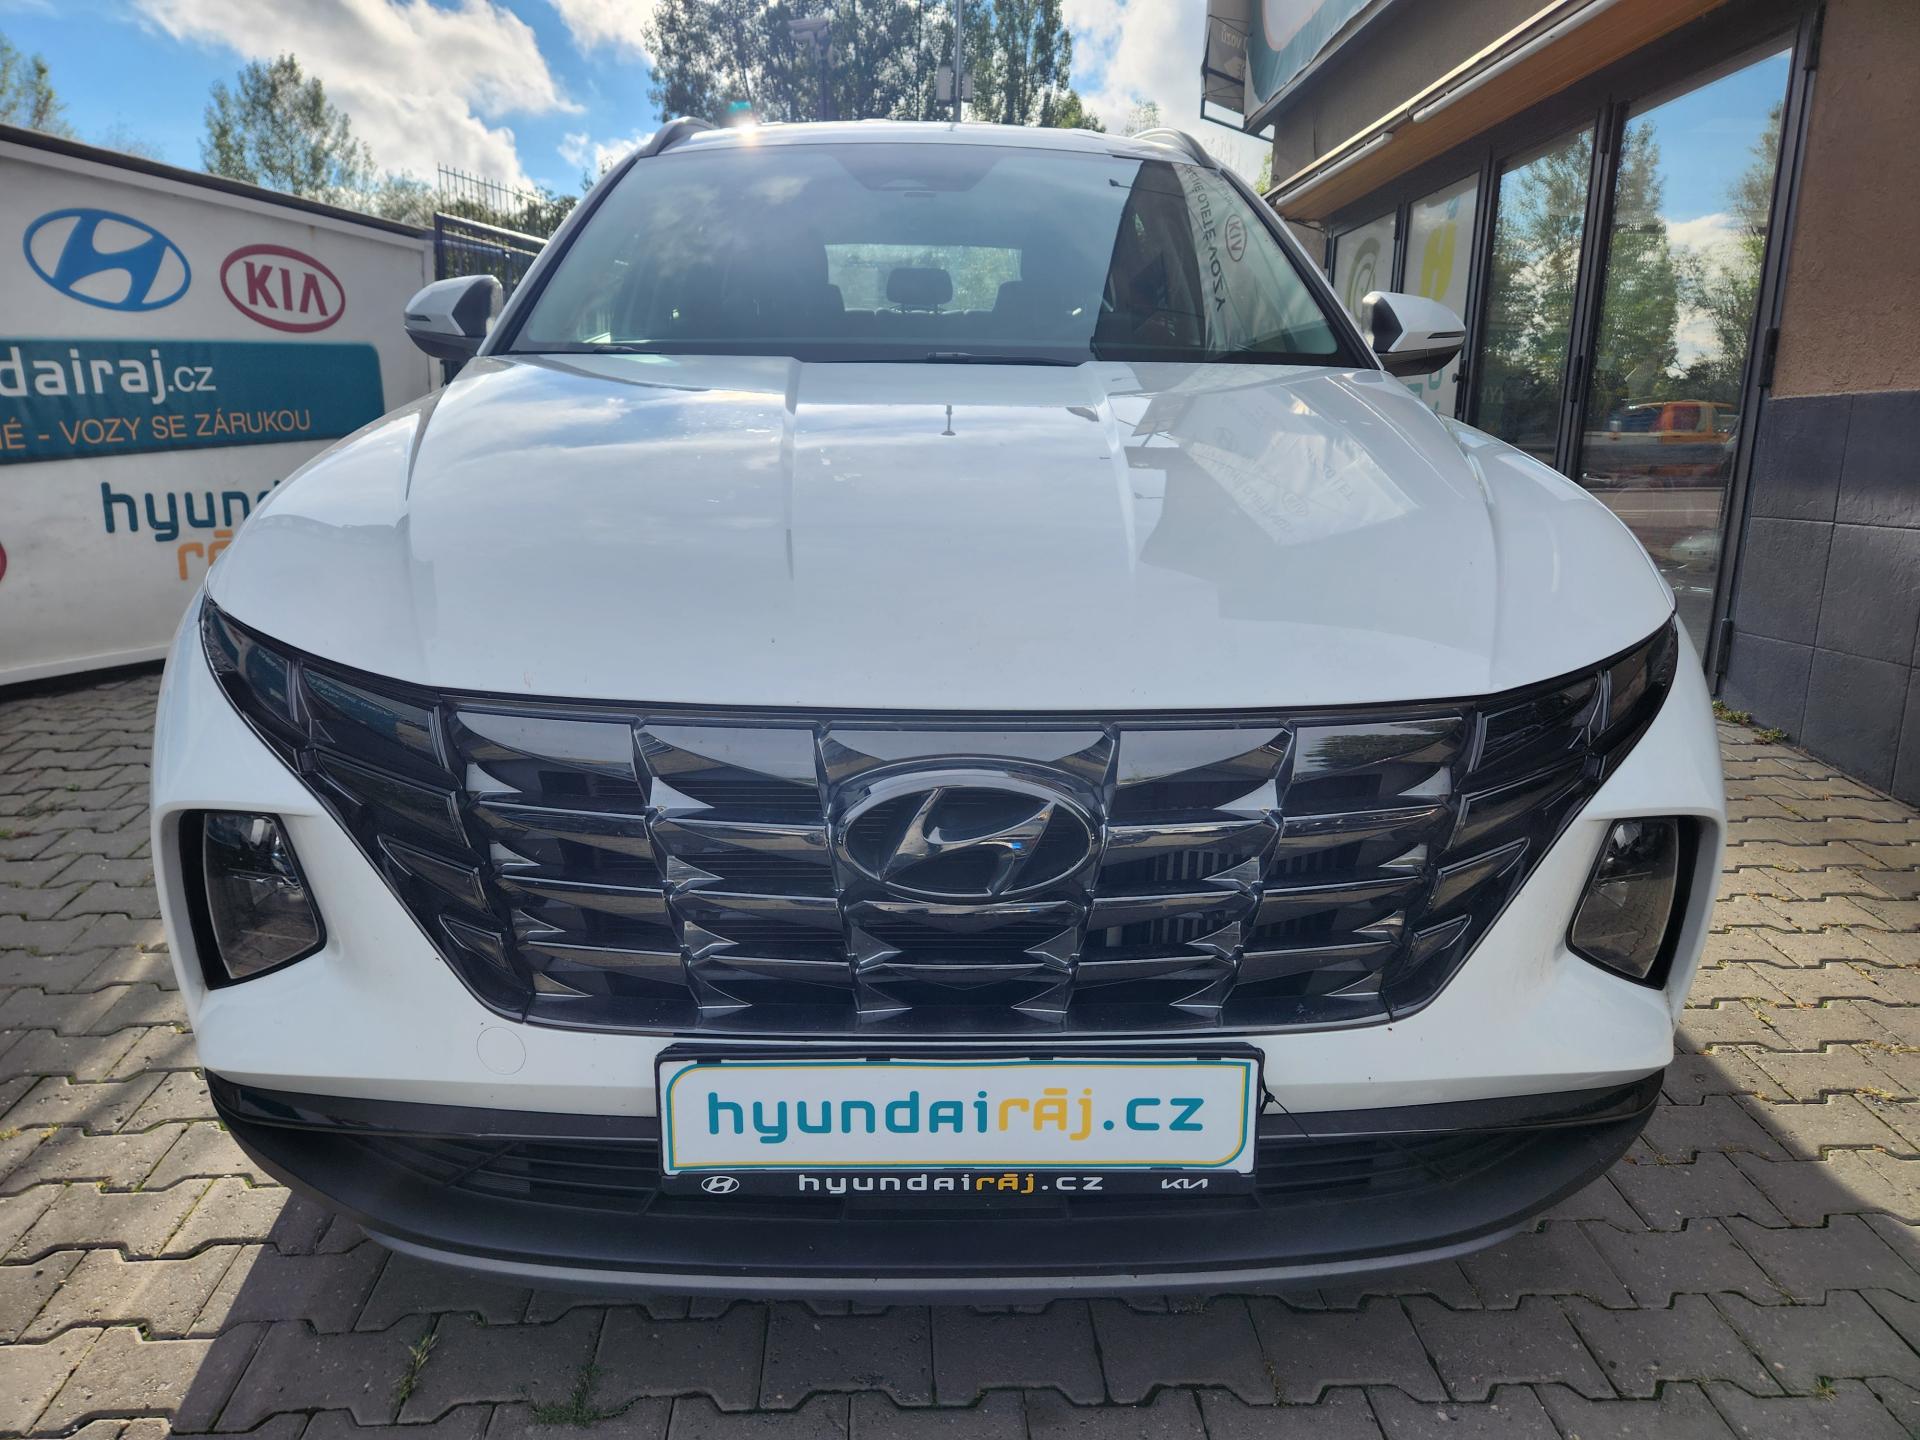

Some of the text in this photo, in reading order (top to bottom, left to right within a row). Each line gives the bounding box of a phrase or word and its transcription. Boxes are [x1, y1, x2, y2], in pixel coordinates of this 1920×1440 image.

[243, 260, 329, 317] KIA
[0, 417, 25, 450] É
[59, 416, 142, 446] VOZY
[152, 413, 188, 440] SE
[196, 408, 312, 435] ZÁRUKOU
